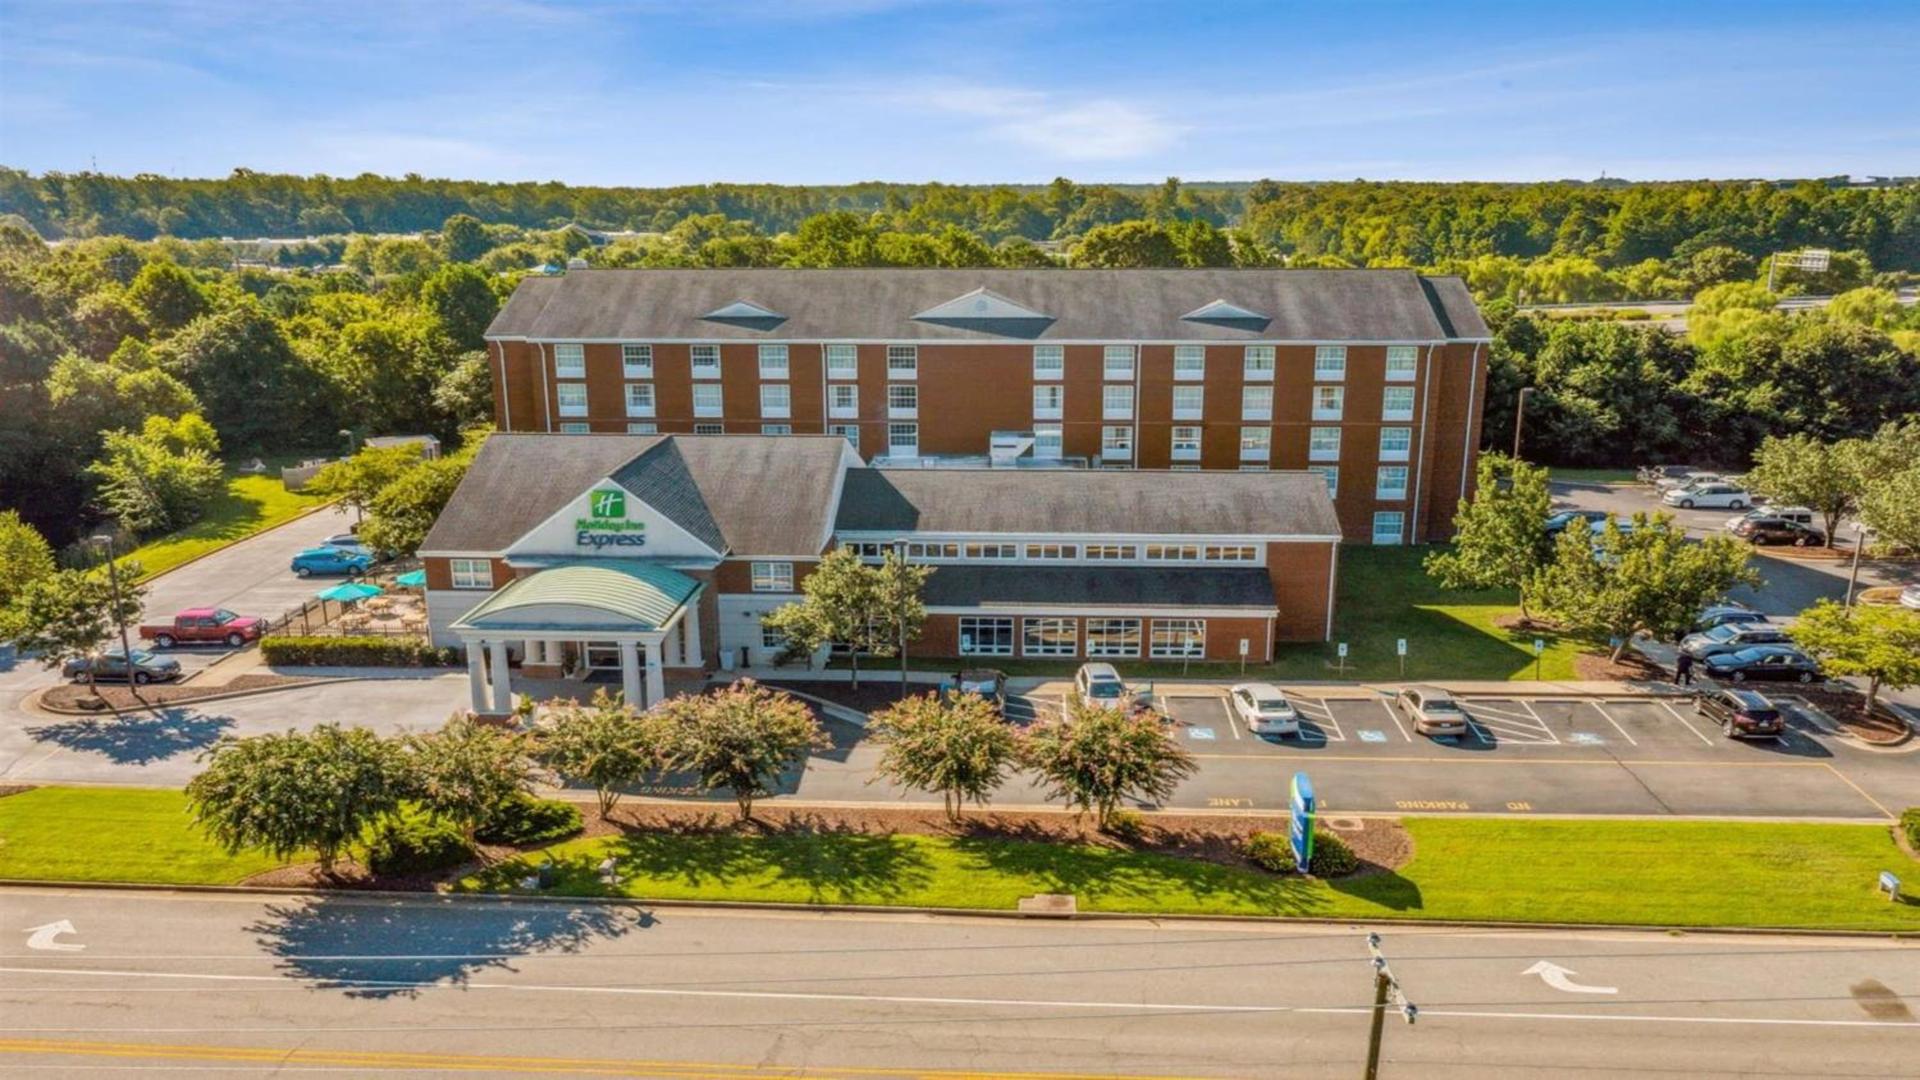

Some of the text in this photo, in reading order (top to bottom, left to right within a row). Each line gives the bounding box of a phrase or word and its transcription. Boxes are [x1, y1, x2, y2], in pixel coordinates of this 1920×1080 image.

[625, 519, 645, 530] Inn
[576, 530, 645, 549] Express
[1207, 798, 1254, 807] LANE
[1395, 800, 1532, 811] NO PARKING
